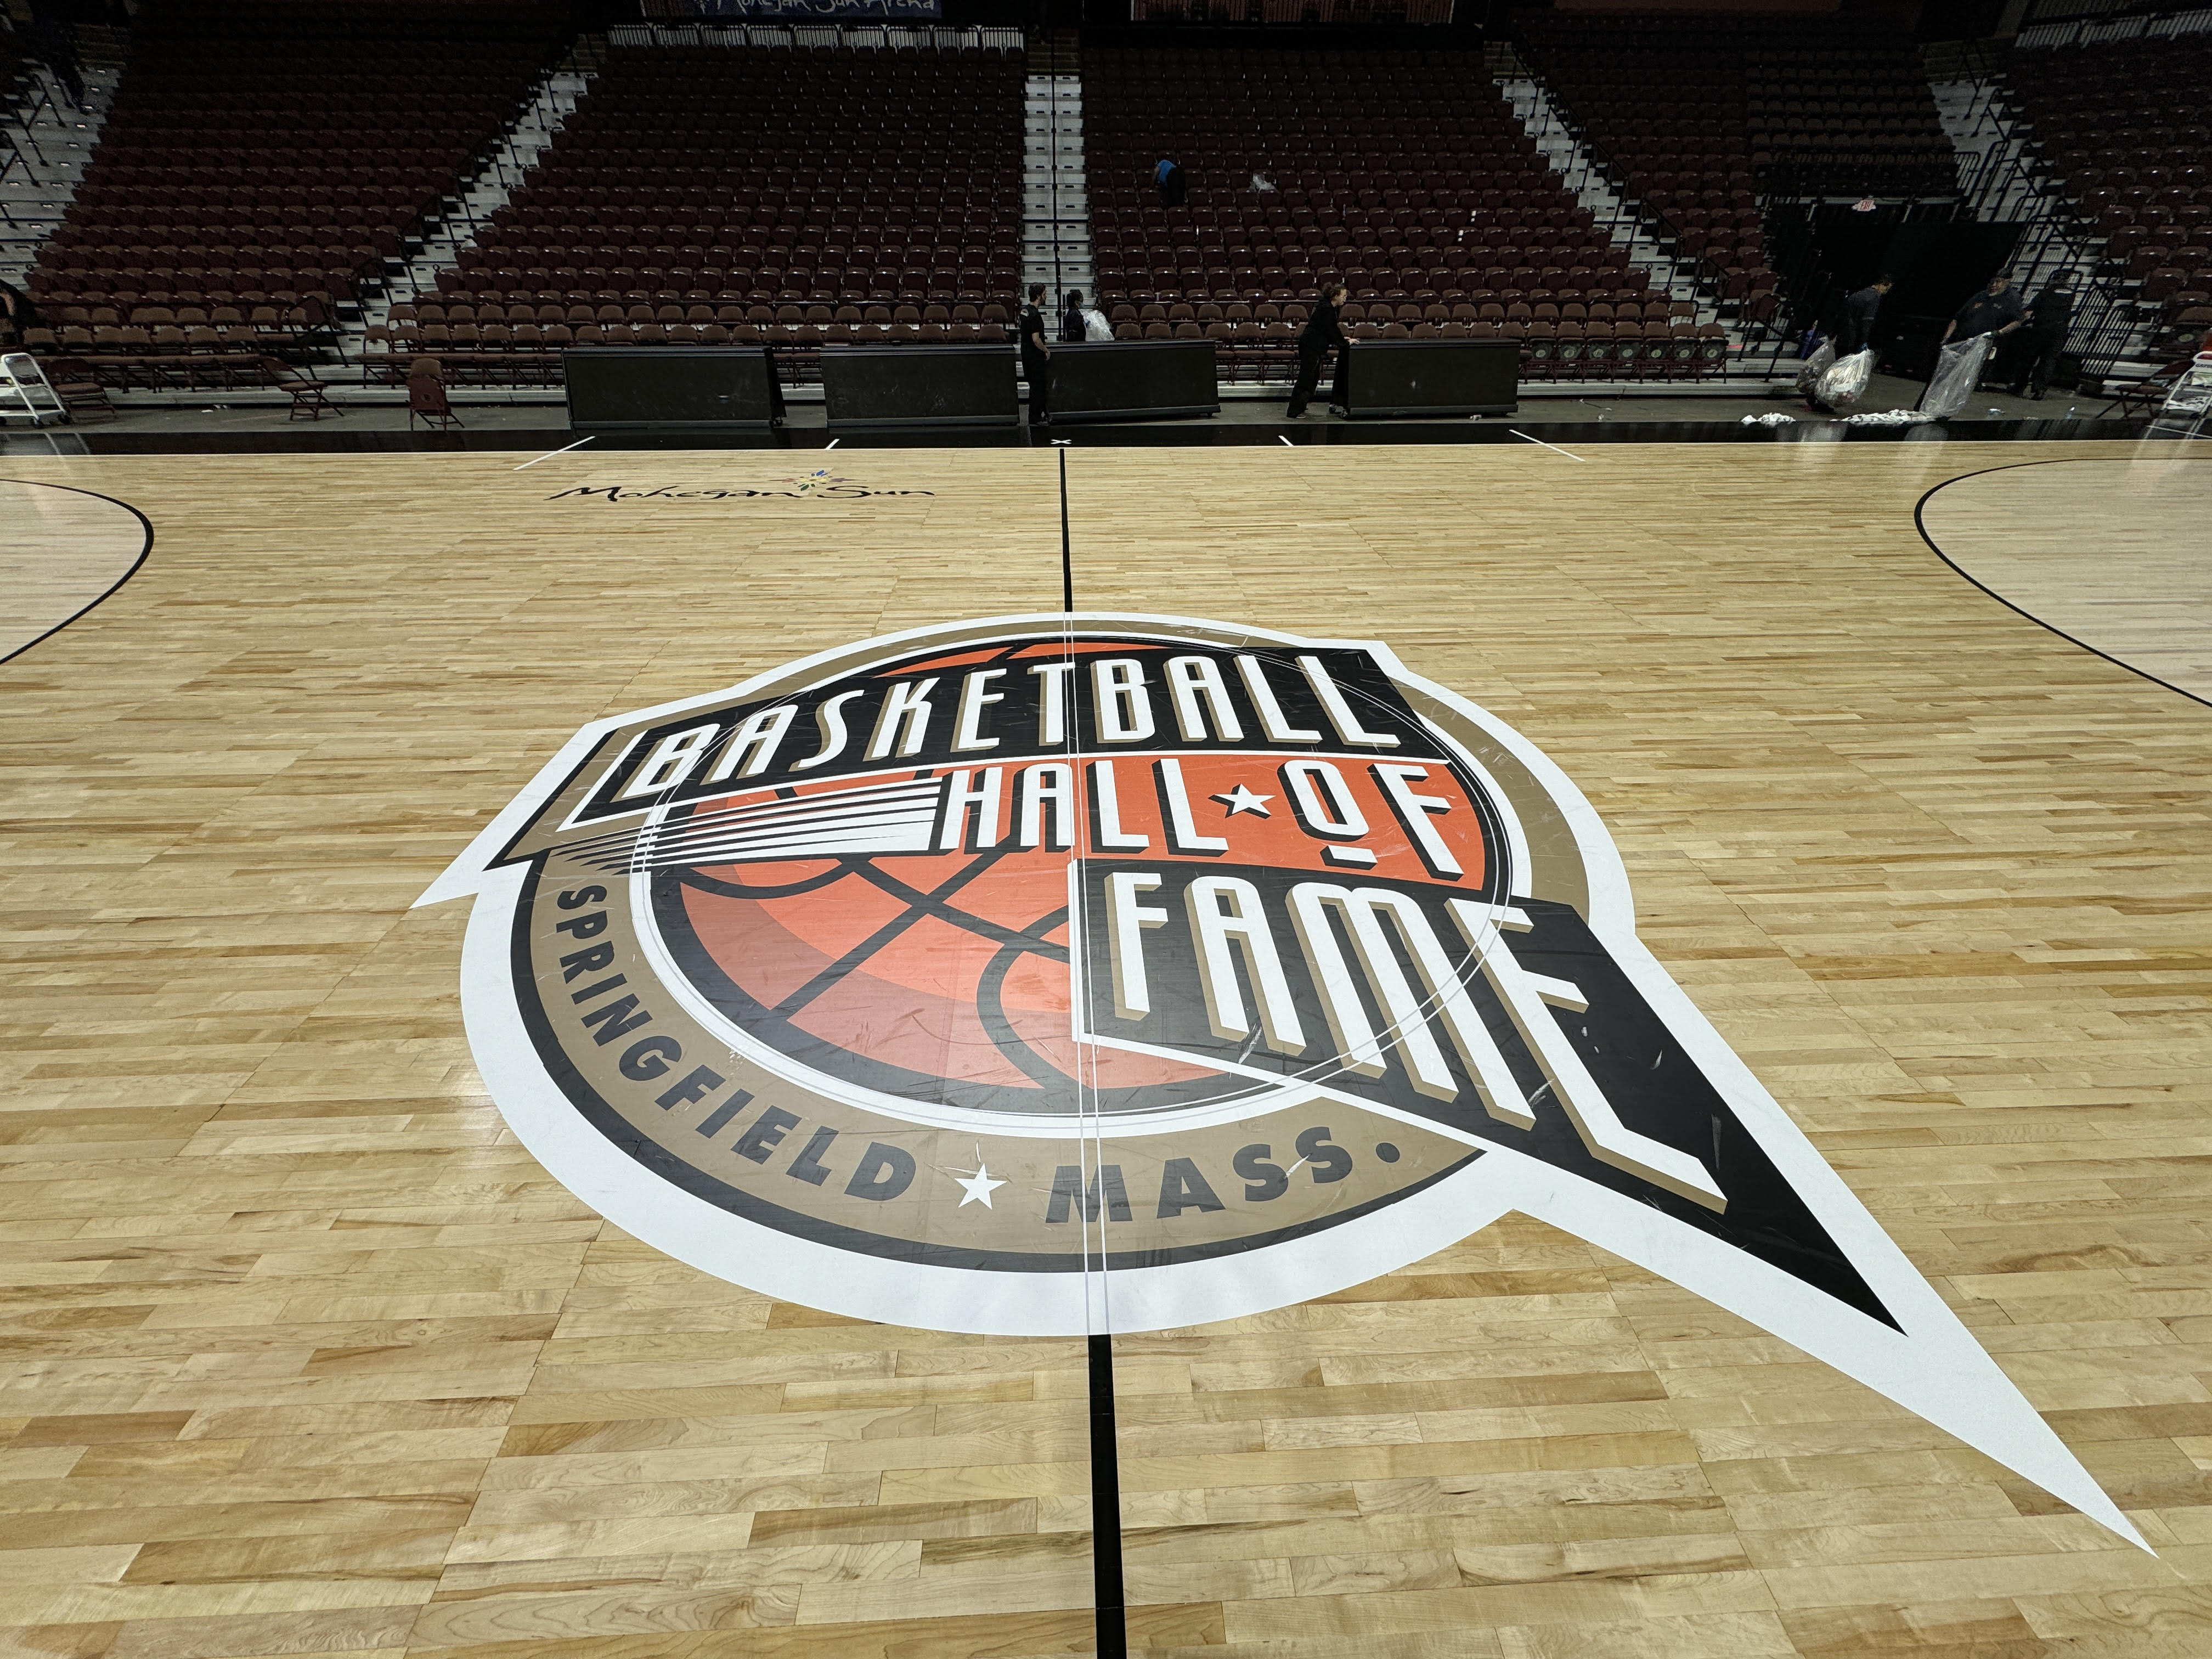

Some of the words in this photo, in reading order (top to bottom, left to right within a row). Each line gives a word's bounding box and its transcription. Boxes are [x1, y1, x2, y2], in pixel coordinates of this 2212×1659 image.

[716, 0, 812, 15] oegan
[543, 485, 802, 503] Mohegan
[816, 485, 935, 499] Sun
[609, 653, 1402, 801] BASKETBALL
[938, 760, 1232, 856] HALL
[1277, 760, 1464, 881] OF
[556, 884, 917, 1201] SPRINGFIELD
[1105, 871, 1729, 1215] FAME
[1045, 1126, 1401, 1223] MASS.
